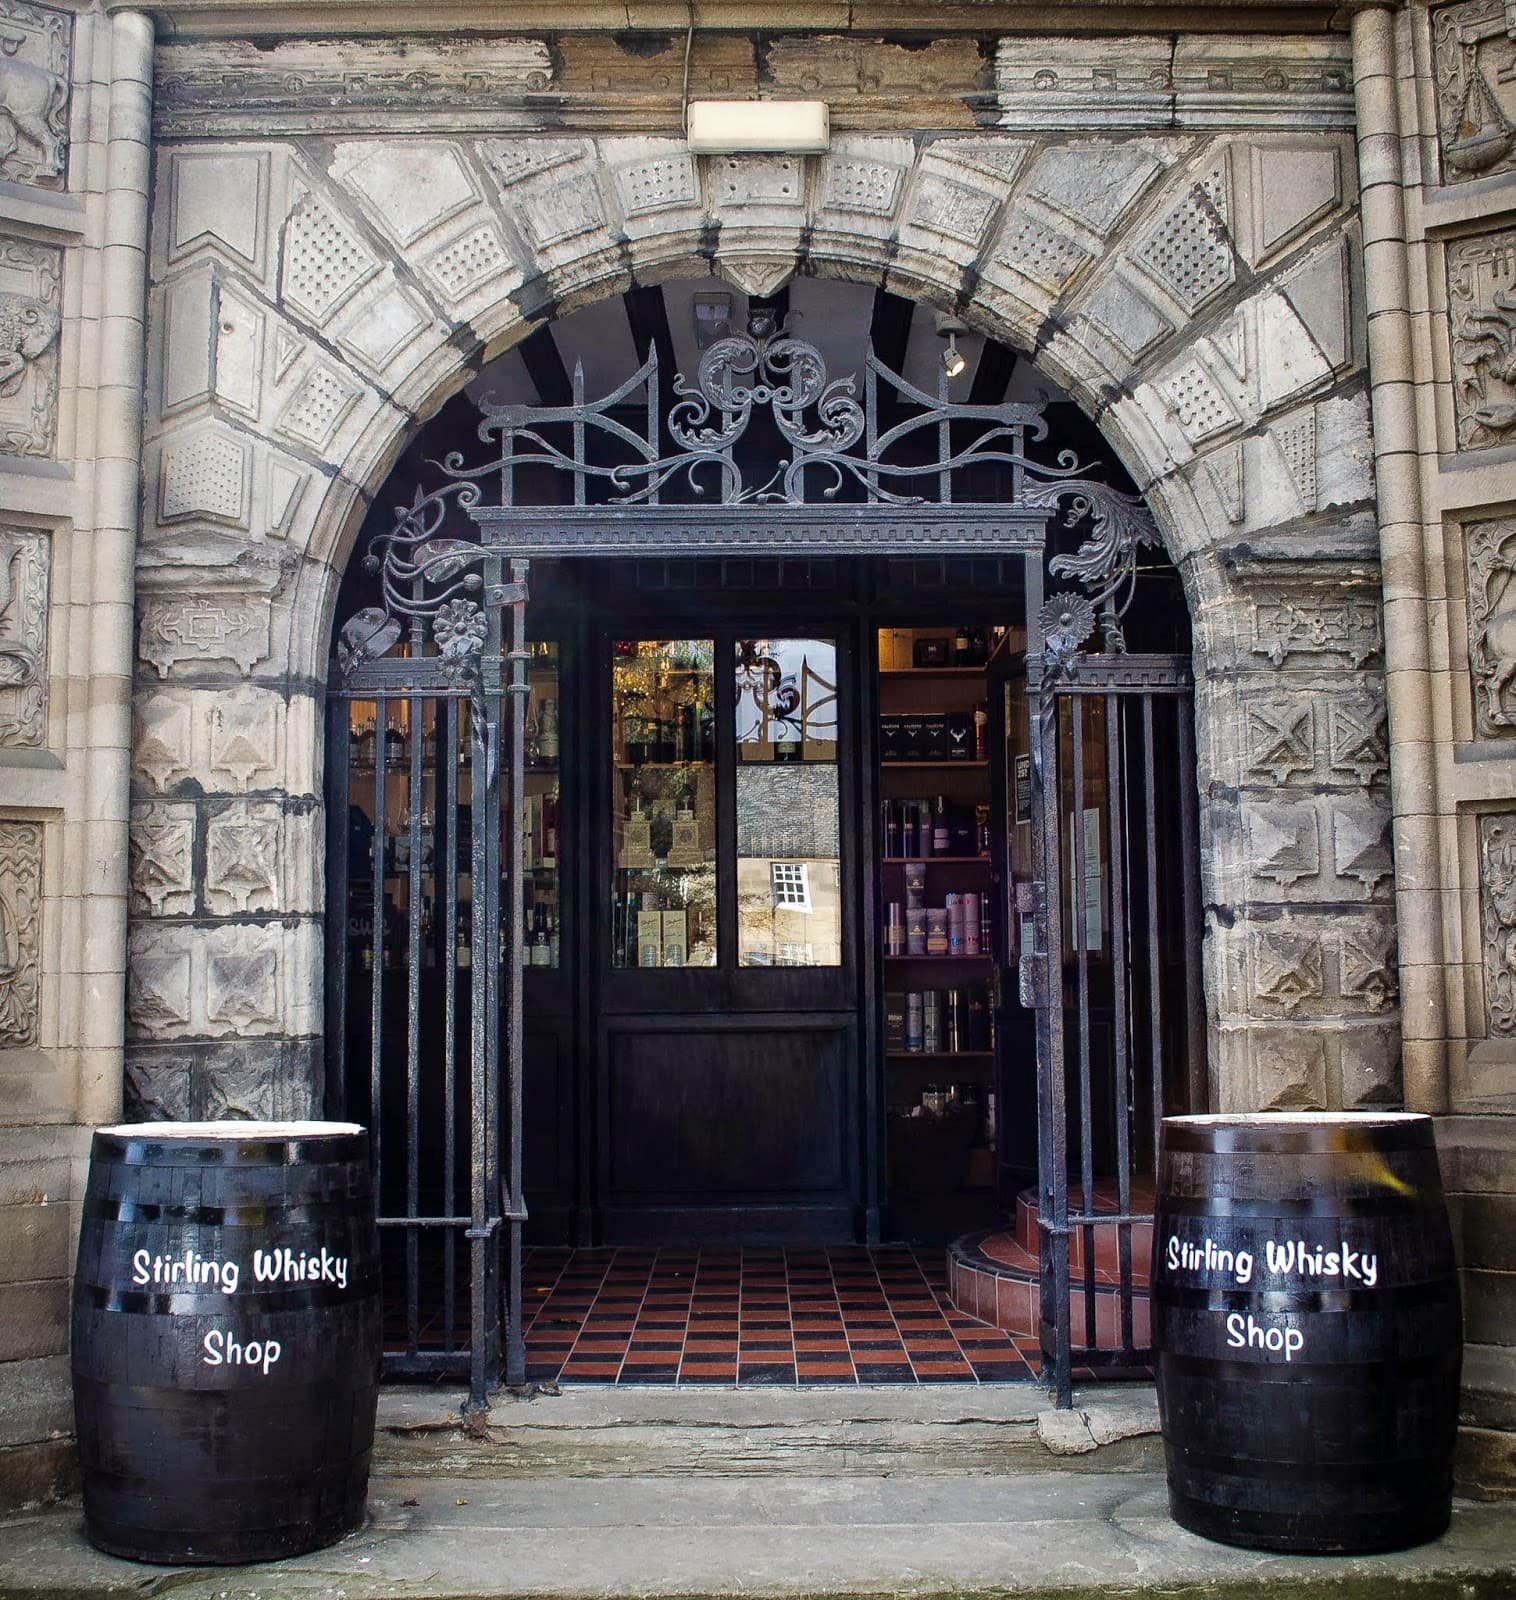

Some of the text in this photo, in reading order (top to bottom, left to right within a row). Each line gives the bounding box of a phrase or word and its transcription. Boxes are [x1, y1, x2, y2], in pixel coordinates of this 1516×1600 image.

[132, 1247, 349, 1294] Stirling Whisky
[1167, 1235, 1377, 1287] Stirling Whisky
[203, 1329, 281, 1375] Shop
[1226, 1313, 1304, 1362] Shop
